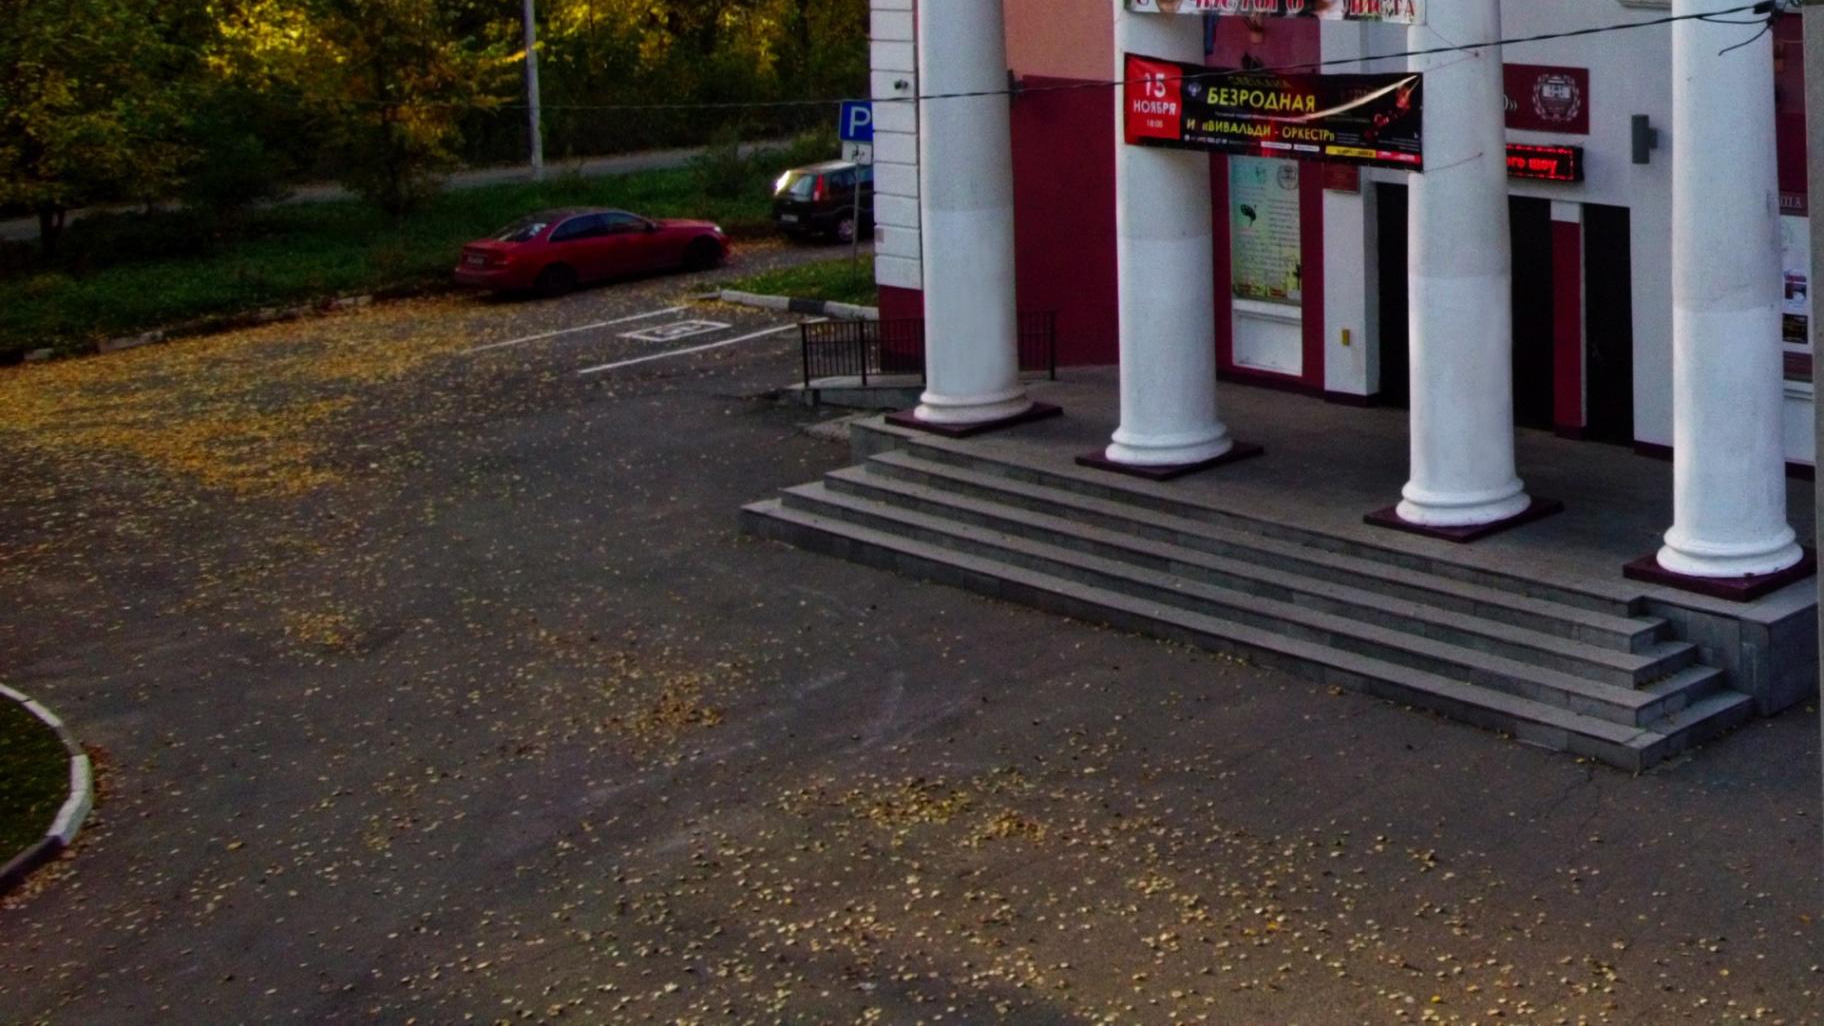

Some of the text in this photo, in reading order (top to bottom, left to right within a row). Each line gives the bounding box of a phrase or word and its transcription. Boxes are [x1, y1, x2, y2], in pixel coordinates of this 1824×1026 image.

[1144, 73, 1167, 98] 15
[1133, 100, 1177, 115] НОЯБРЯ
[1207, 87, 1316, 112] БЕЗРОДНАЯ
[1186, 118, 1196, 130] И
